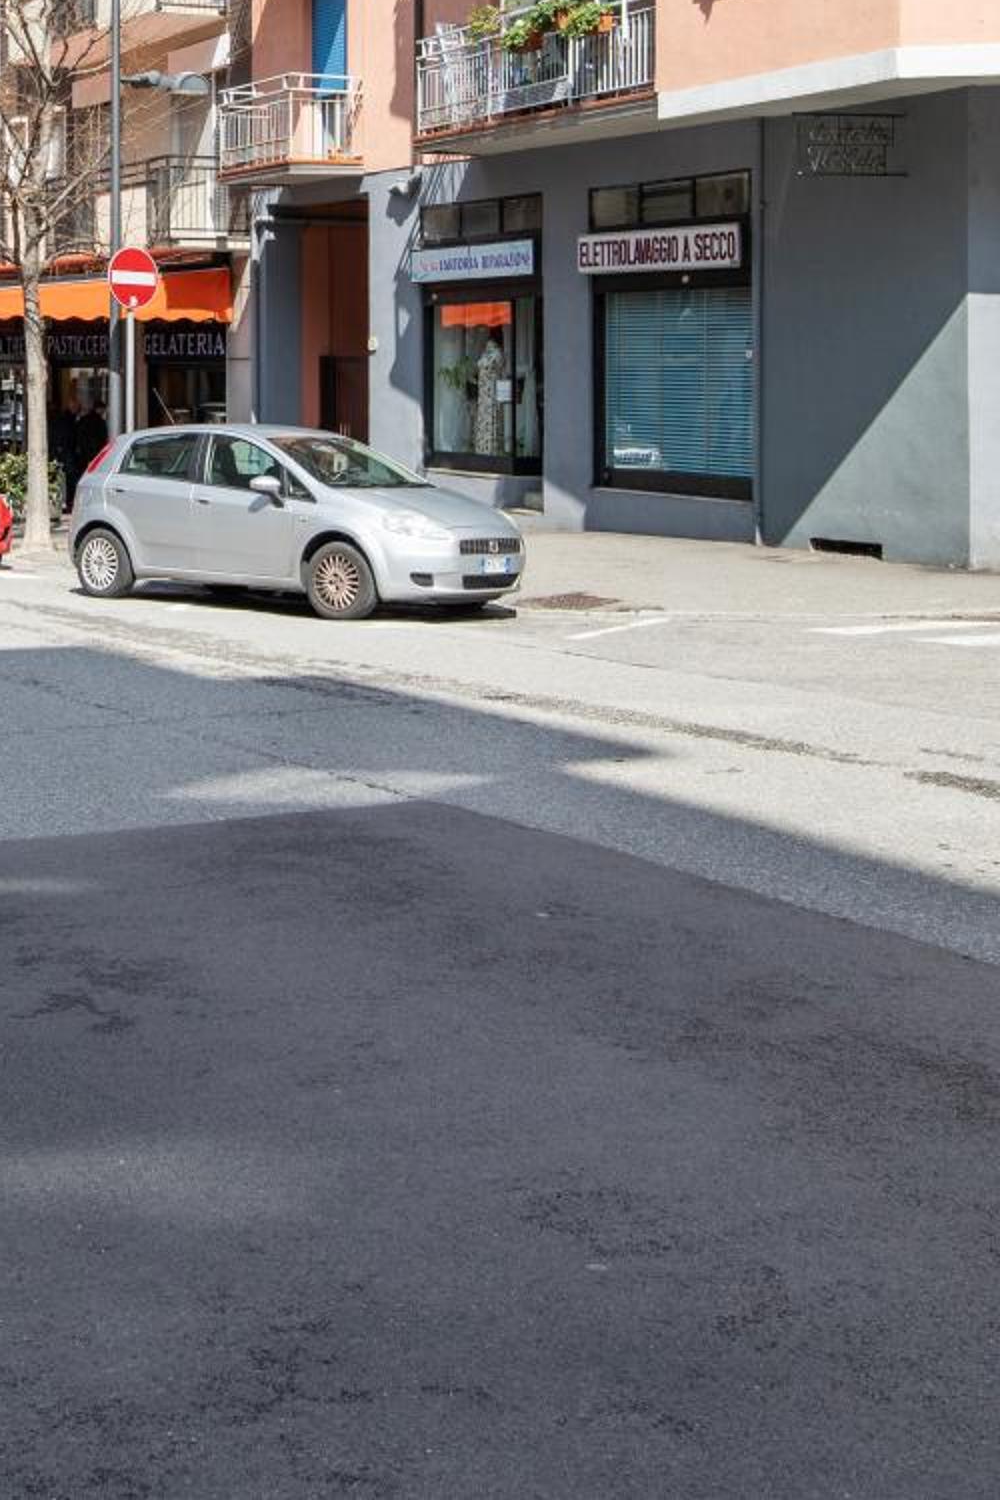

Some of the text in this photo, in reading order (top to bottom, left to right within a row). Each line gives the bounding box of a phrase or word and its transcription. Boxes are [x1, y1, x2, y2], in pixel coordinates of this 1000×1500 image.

[579, 231, 736, 267] ELETTROLAVAGGIO A SECCO
[143, 332, 226, 356] GELATERIA
